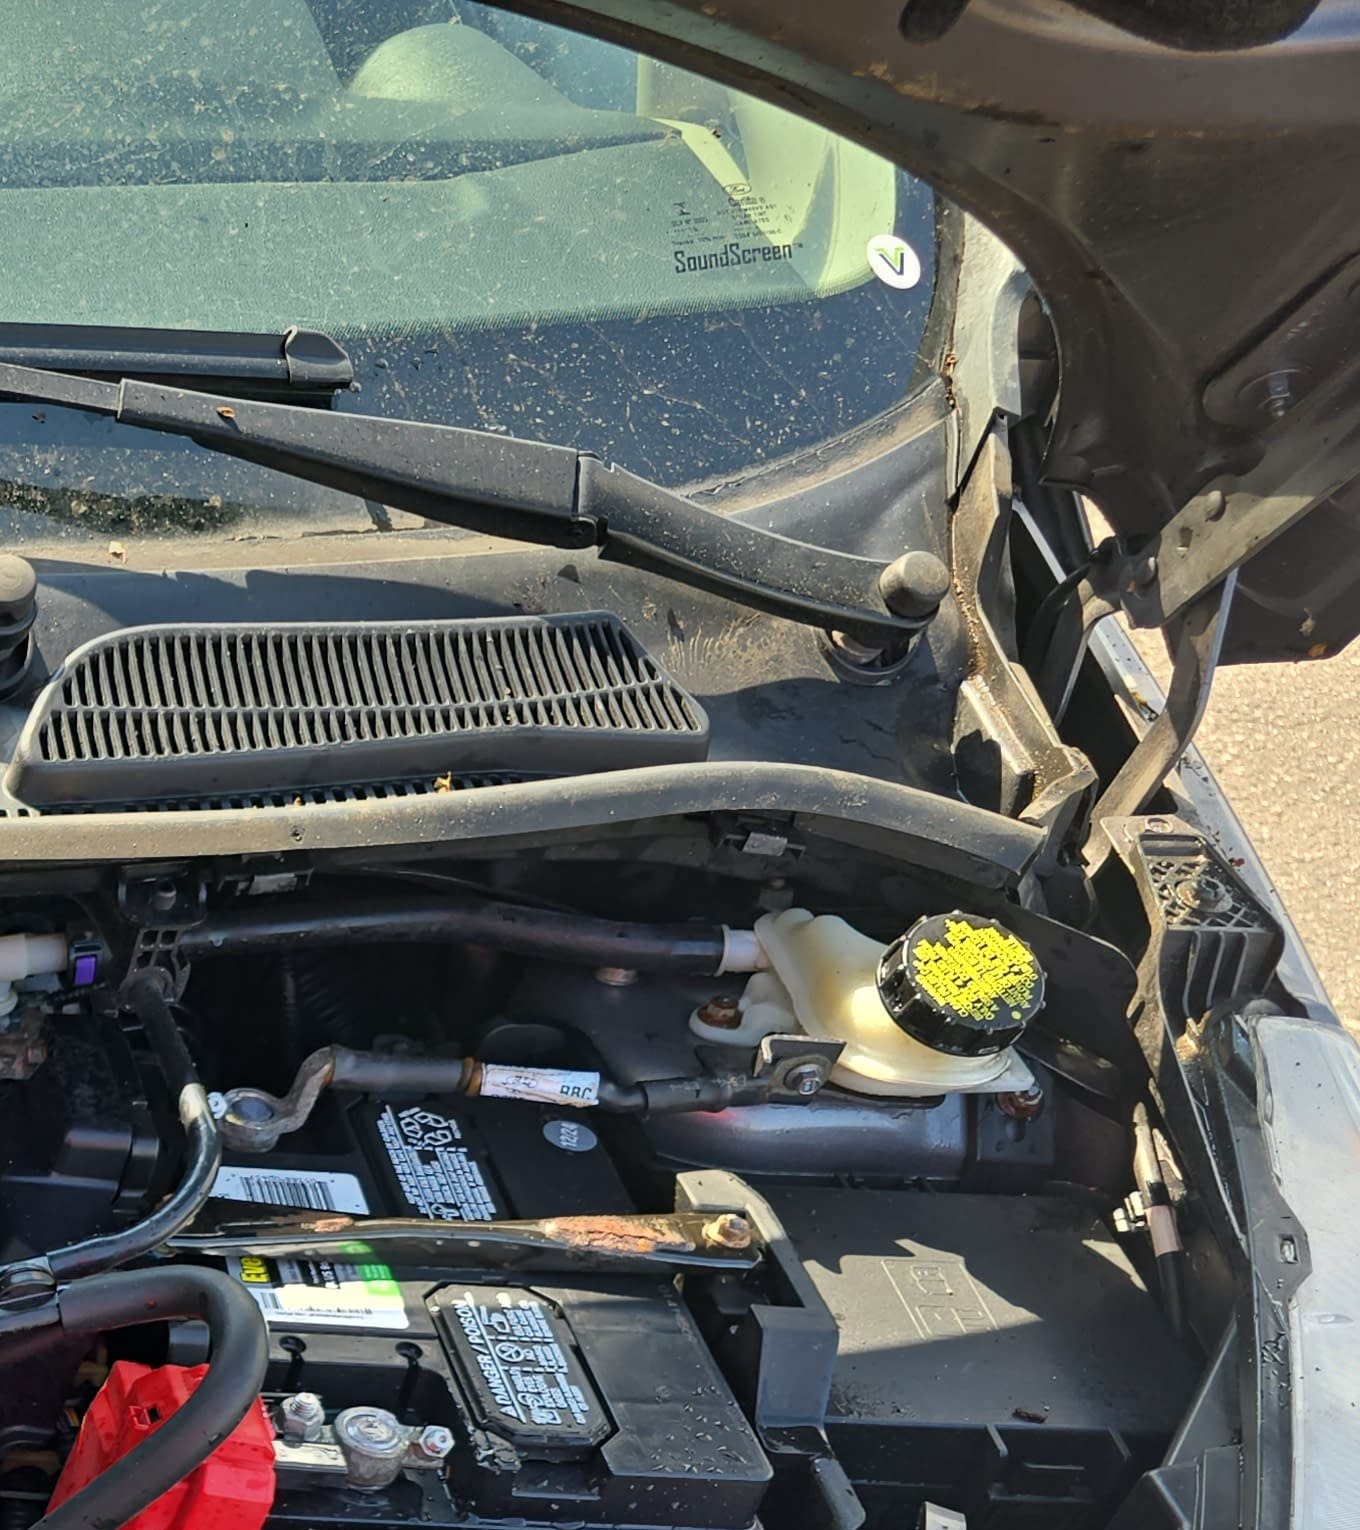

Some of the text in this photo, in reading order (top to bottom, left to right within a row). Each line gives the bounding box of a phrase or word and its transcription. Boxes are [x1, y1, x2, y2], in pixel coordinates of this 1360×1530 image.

[675, 243, 793, 273] SoundScreen
[452, 1299, 485, 1344] POISON
[477, 1354, 513, 1405] DANGER
